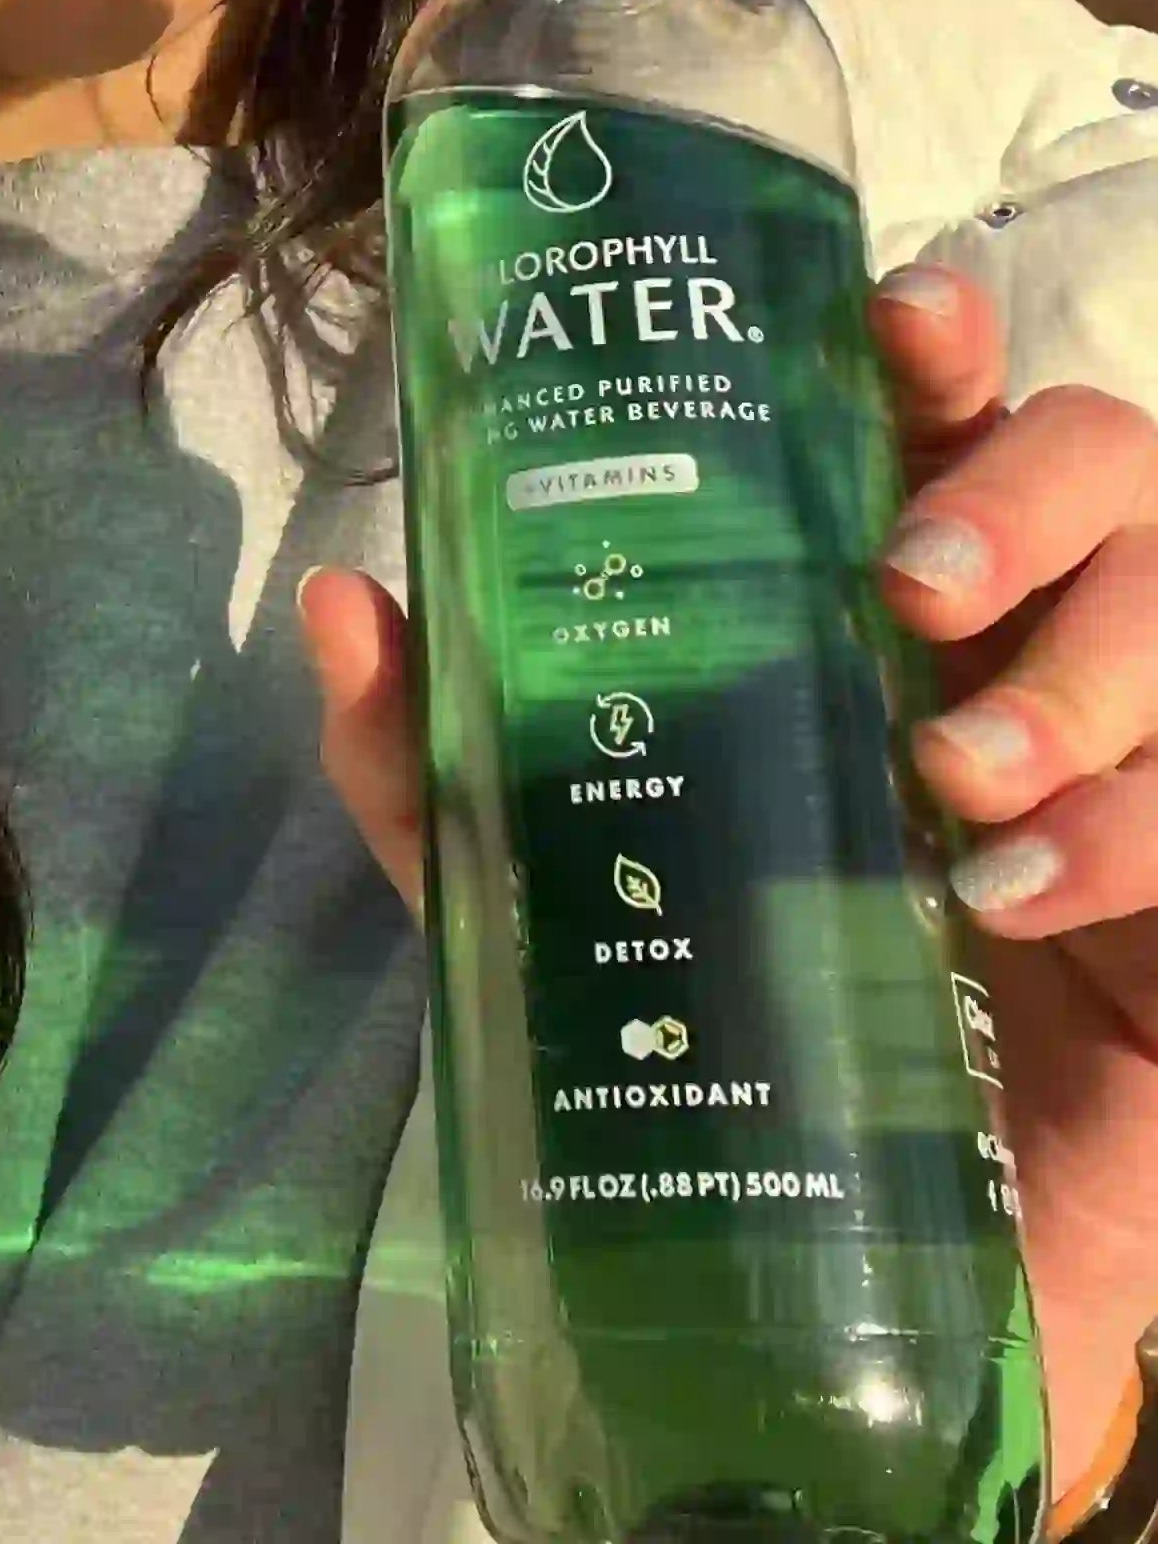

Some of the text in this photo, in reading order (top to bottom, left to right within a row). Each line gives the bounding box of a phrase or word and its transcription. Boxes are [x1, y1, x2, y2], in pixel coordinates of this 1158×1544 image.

[498, 234, 718, 285] LOROPHYLL
[484, 374, 732, 415] ANCED PURIFIED
[528, 401, 772, 433] WATER BEVERAGE
[552, 616, 671, 644] OXYGEN
[569, 775, 685, 805] ENERGY
[594, 937, 693, 964] DETOX
[553, 1081, 771, 1113] ANTIOXIDANT
[520, 1176, 565, 1201] 16.9
[696, 1171, 741, 1202] PT)
[745, 1171, 801, 1197] 500
[804, 1171, 845, 1199] ML
